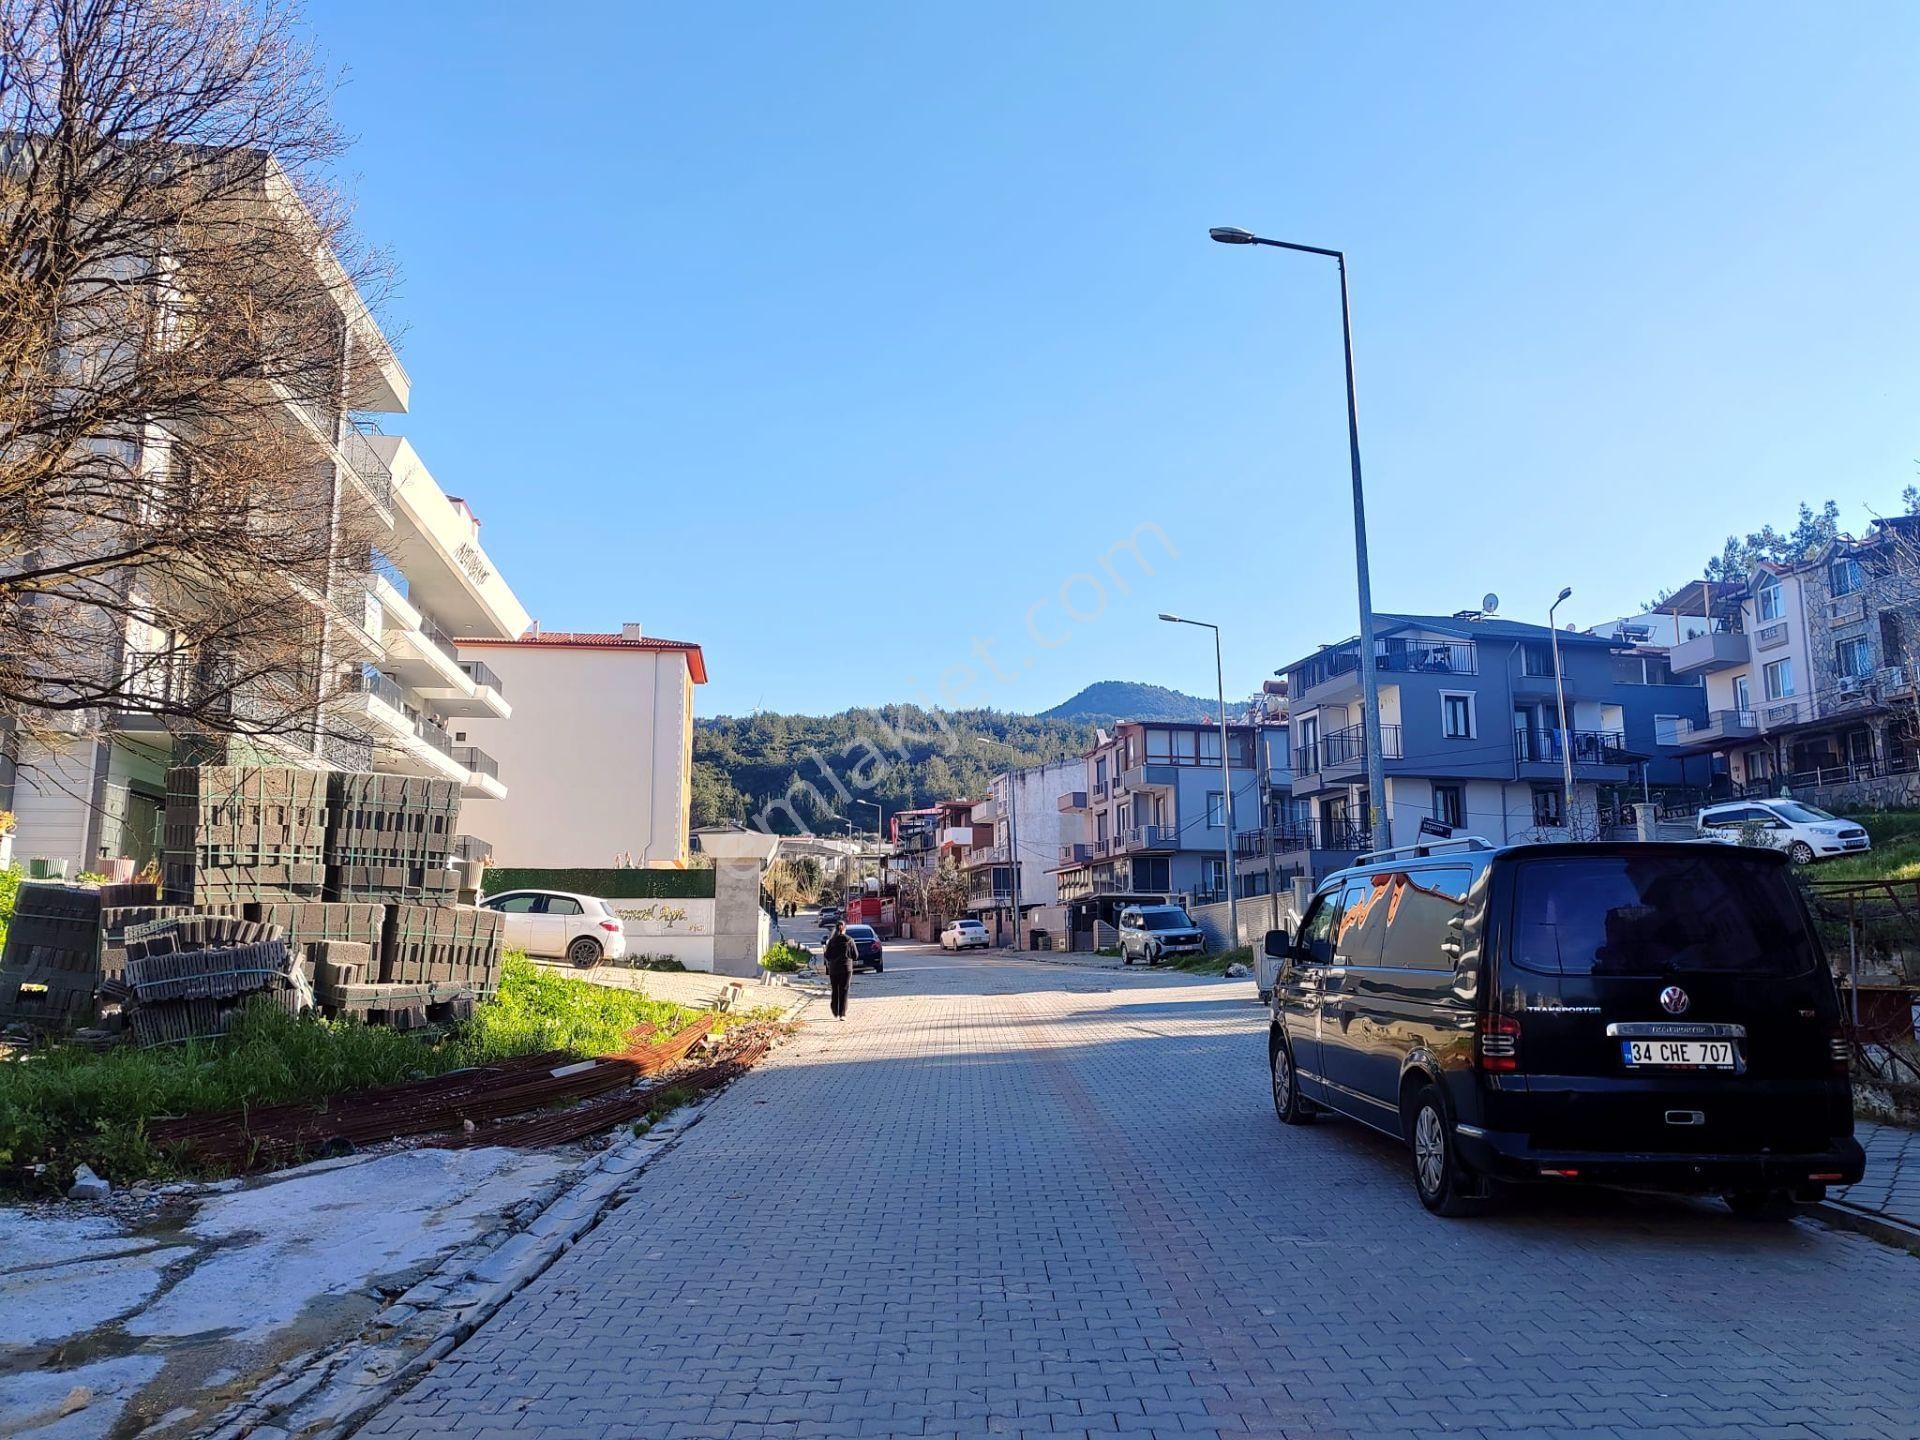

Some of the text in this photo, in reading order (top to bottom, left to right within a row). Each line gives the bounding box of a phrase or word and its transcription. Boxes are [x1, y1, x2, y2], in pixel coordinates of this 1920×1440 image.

[1632, 1044, 1728, 1062] 34 CHE 707
